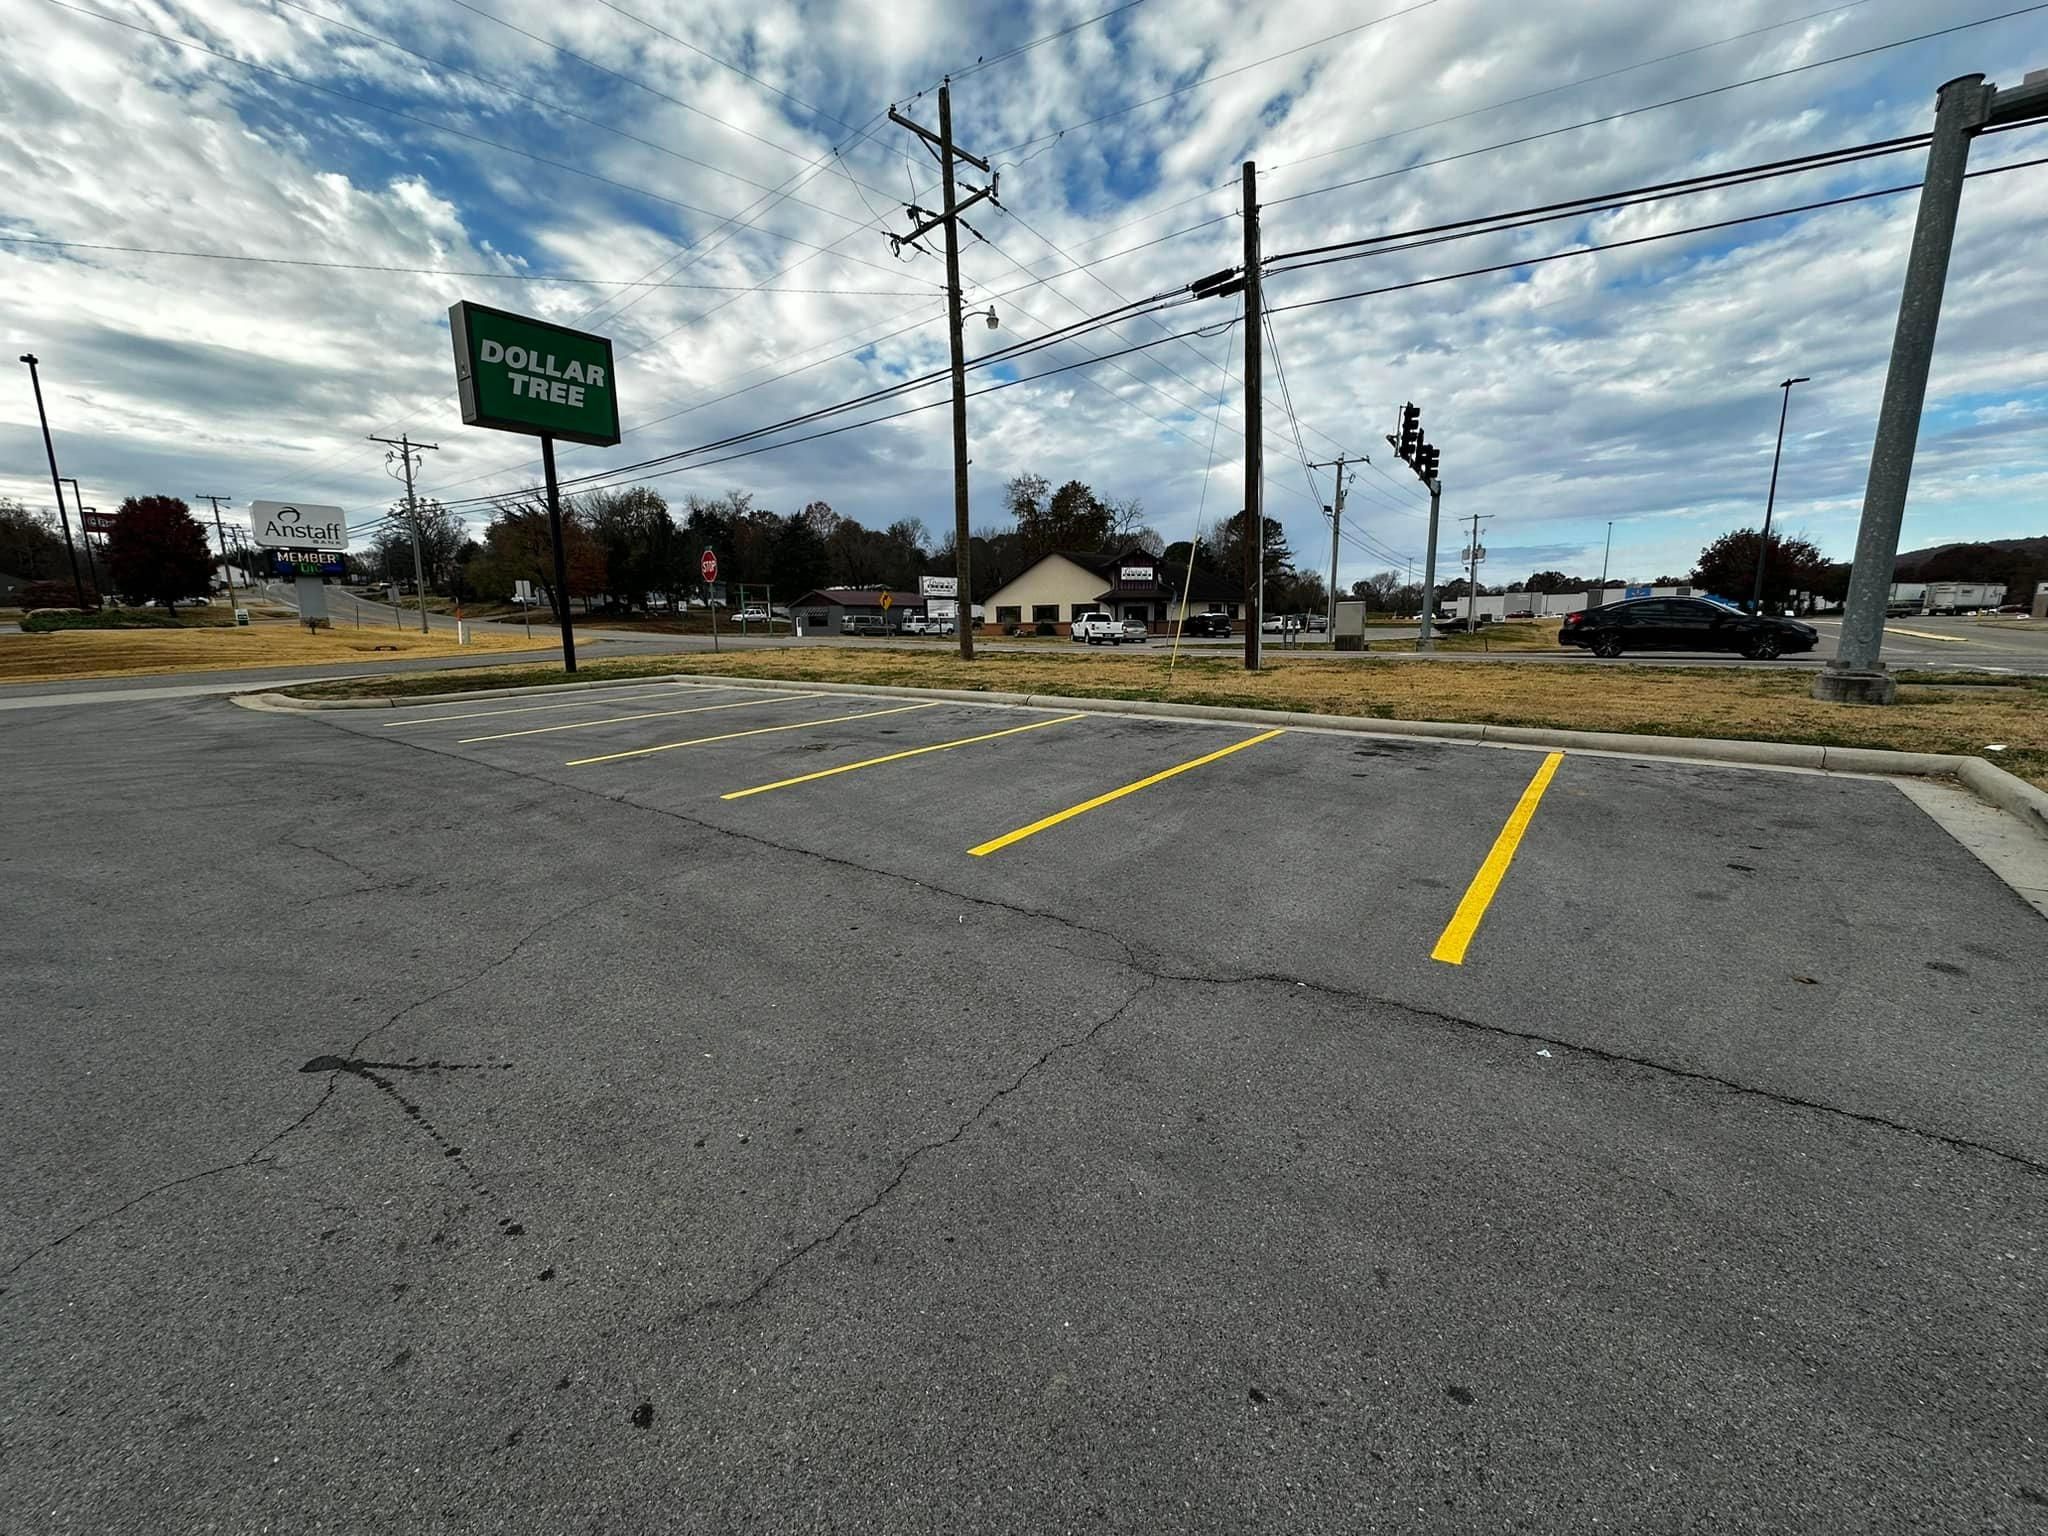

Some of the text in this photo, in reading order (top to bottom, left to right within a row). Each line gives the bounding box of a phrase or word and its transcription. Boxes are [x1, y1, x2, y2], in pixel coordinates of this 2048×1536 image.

[480, 339, 605, 387] DOLLAR
[508, 371, 585, 408] TREE
[265, 520, 341, 539] Anstaff
[277, 552, 336, 563] MEMBER
[703, 560, 716, 572] STOP
